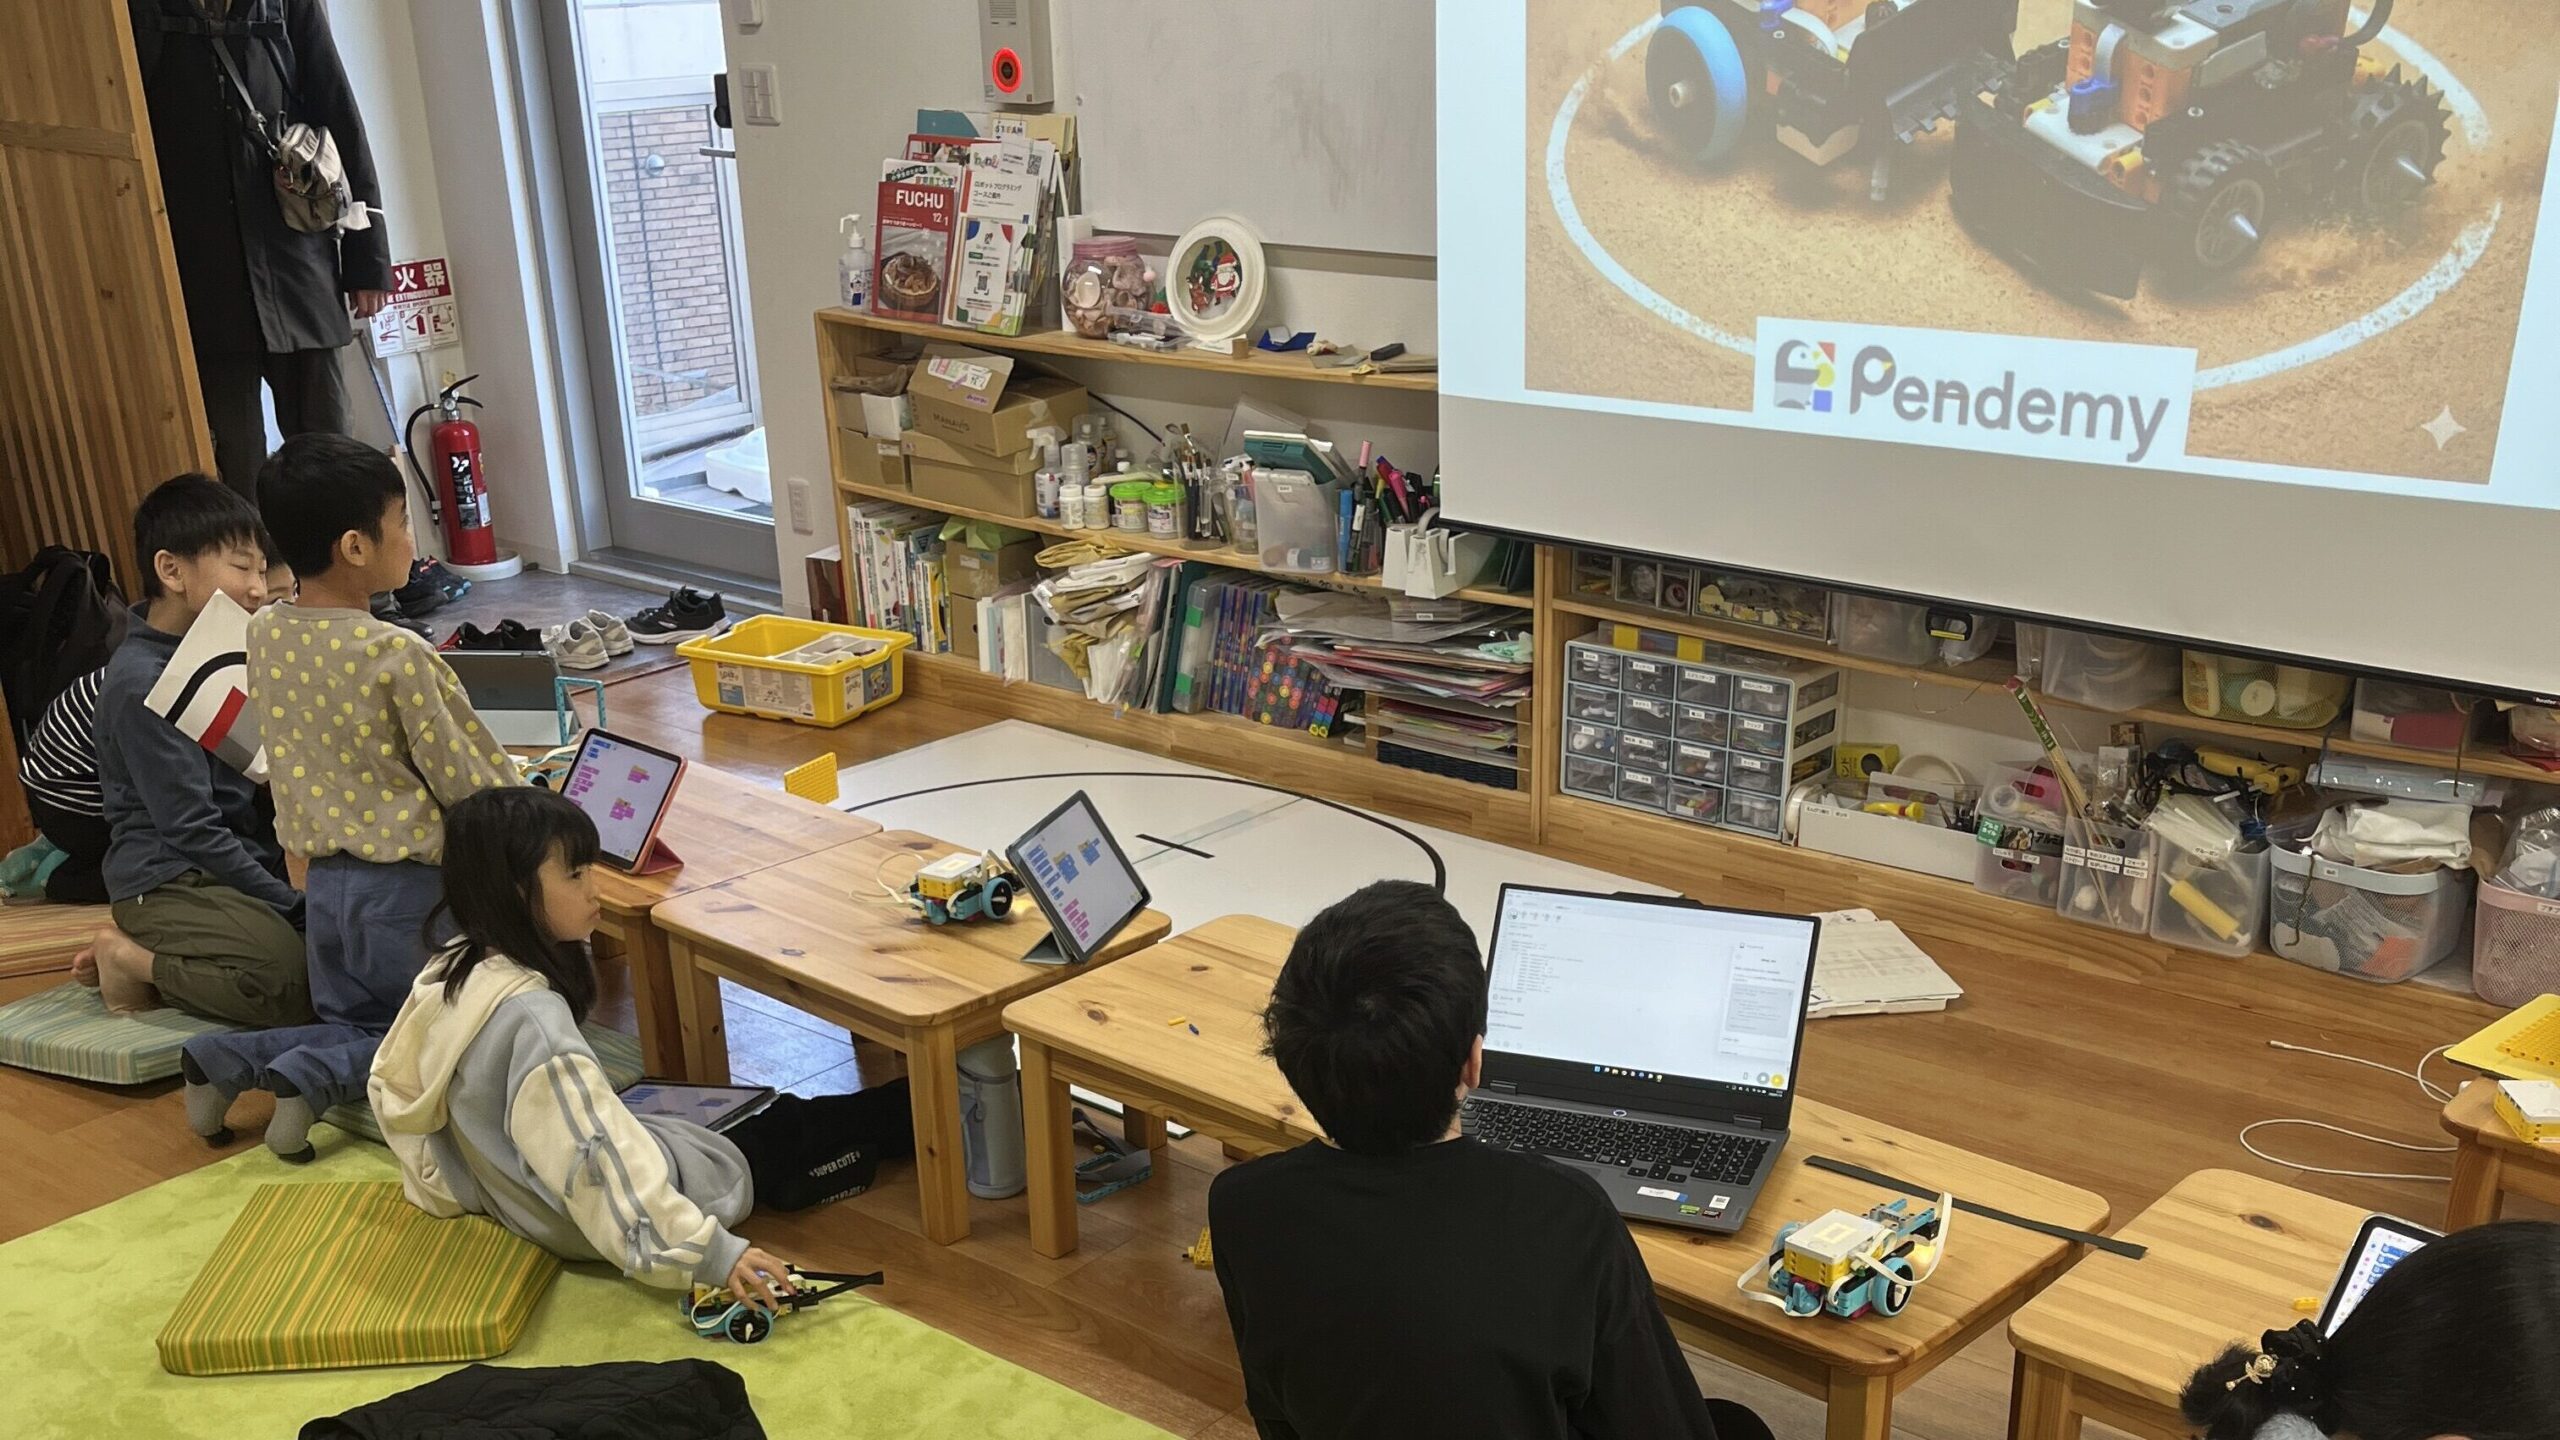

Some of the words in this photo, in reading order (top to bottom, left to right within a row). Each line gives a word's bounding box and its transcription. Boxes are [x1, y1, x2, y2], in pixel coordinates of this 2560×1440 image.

[995, 125, 1023, 134] STEAM
[974, 181, 1022, 192] ロボットプログラミング
[895, 189, 944, 209] FUCHU
[1850, 345, 2169, 463] Pendemy
[813, 1161, 838, 1177] SUPER
[836, 1151, 857, 1168] CUTE
